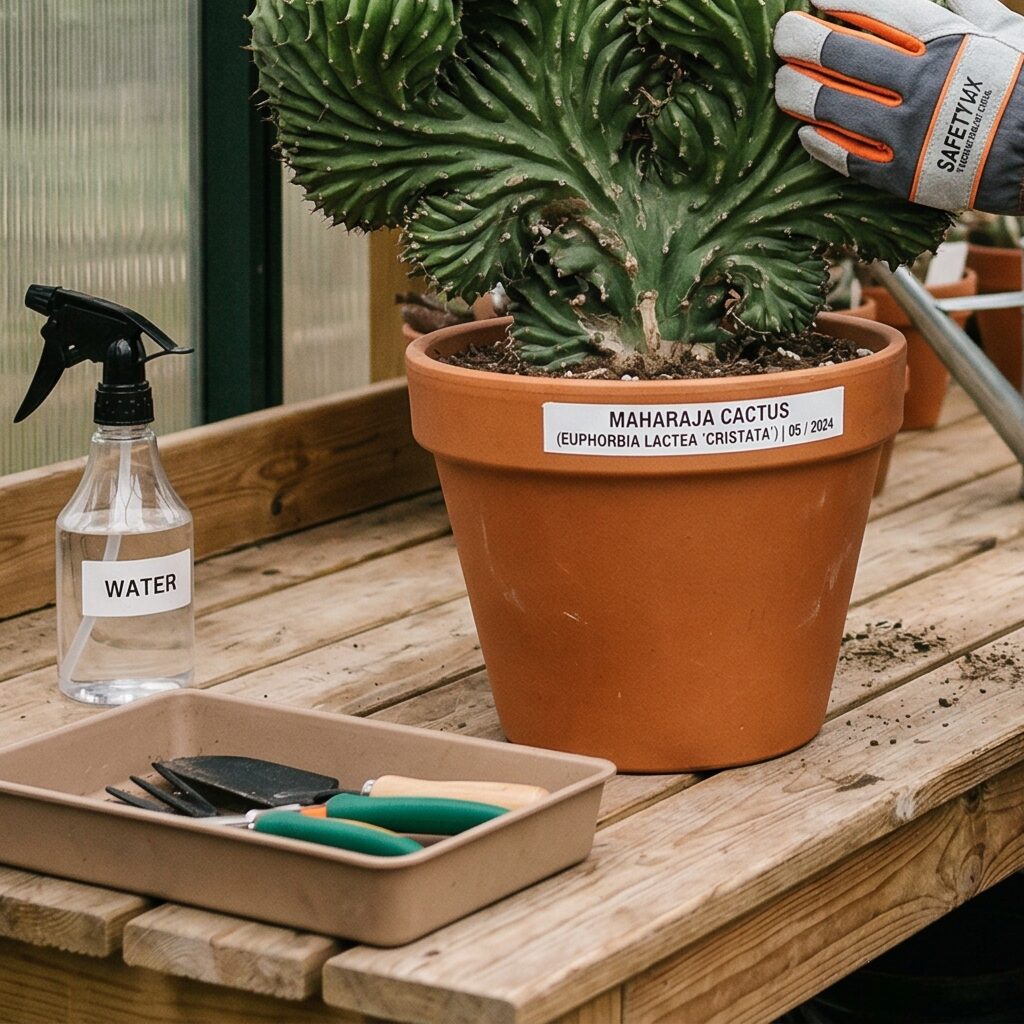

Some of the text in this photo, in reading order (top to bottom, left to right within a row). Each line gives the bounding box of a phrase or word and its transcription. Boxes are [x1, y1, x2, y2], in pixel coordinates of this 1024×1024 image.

[609, 402, 790, 428] MAHARAJA CACTUS
[556, 431, 641, 448] (EUPHORBIA
[644, 433, 698, 448] LACTEA
[788, 423, 802, 437] 05
[810, 417, 834, 433] 2024
[104, 573, 177, 598] WATER
